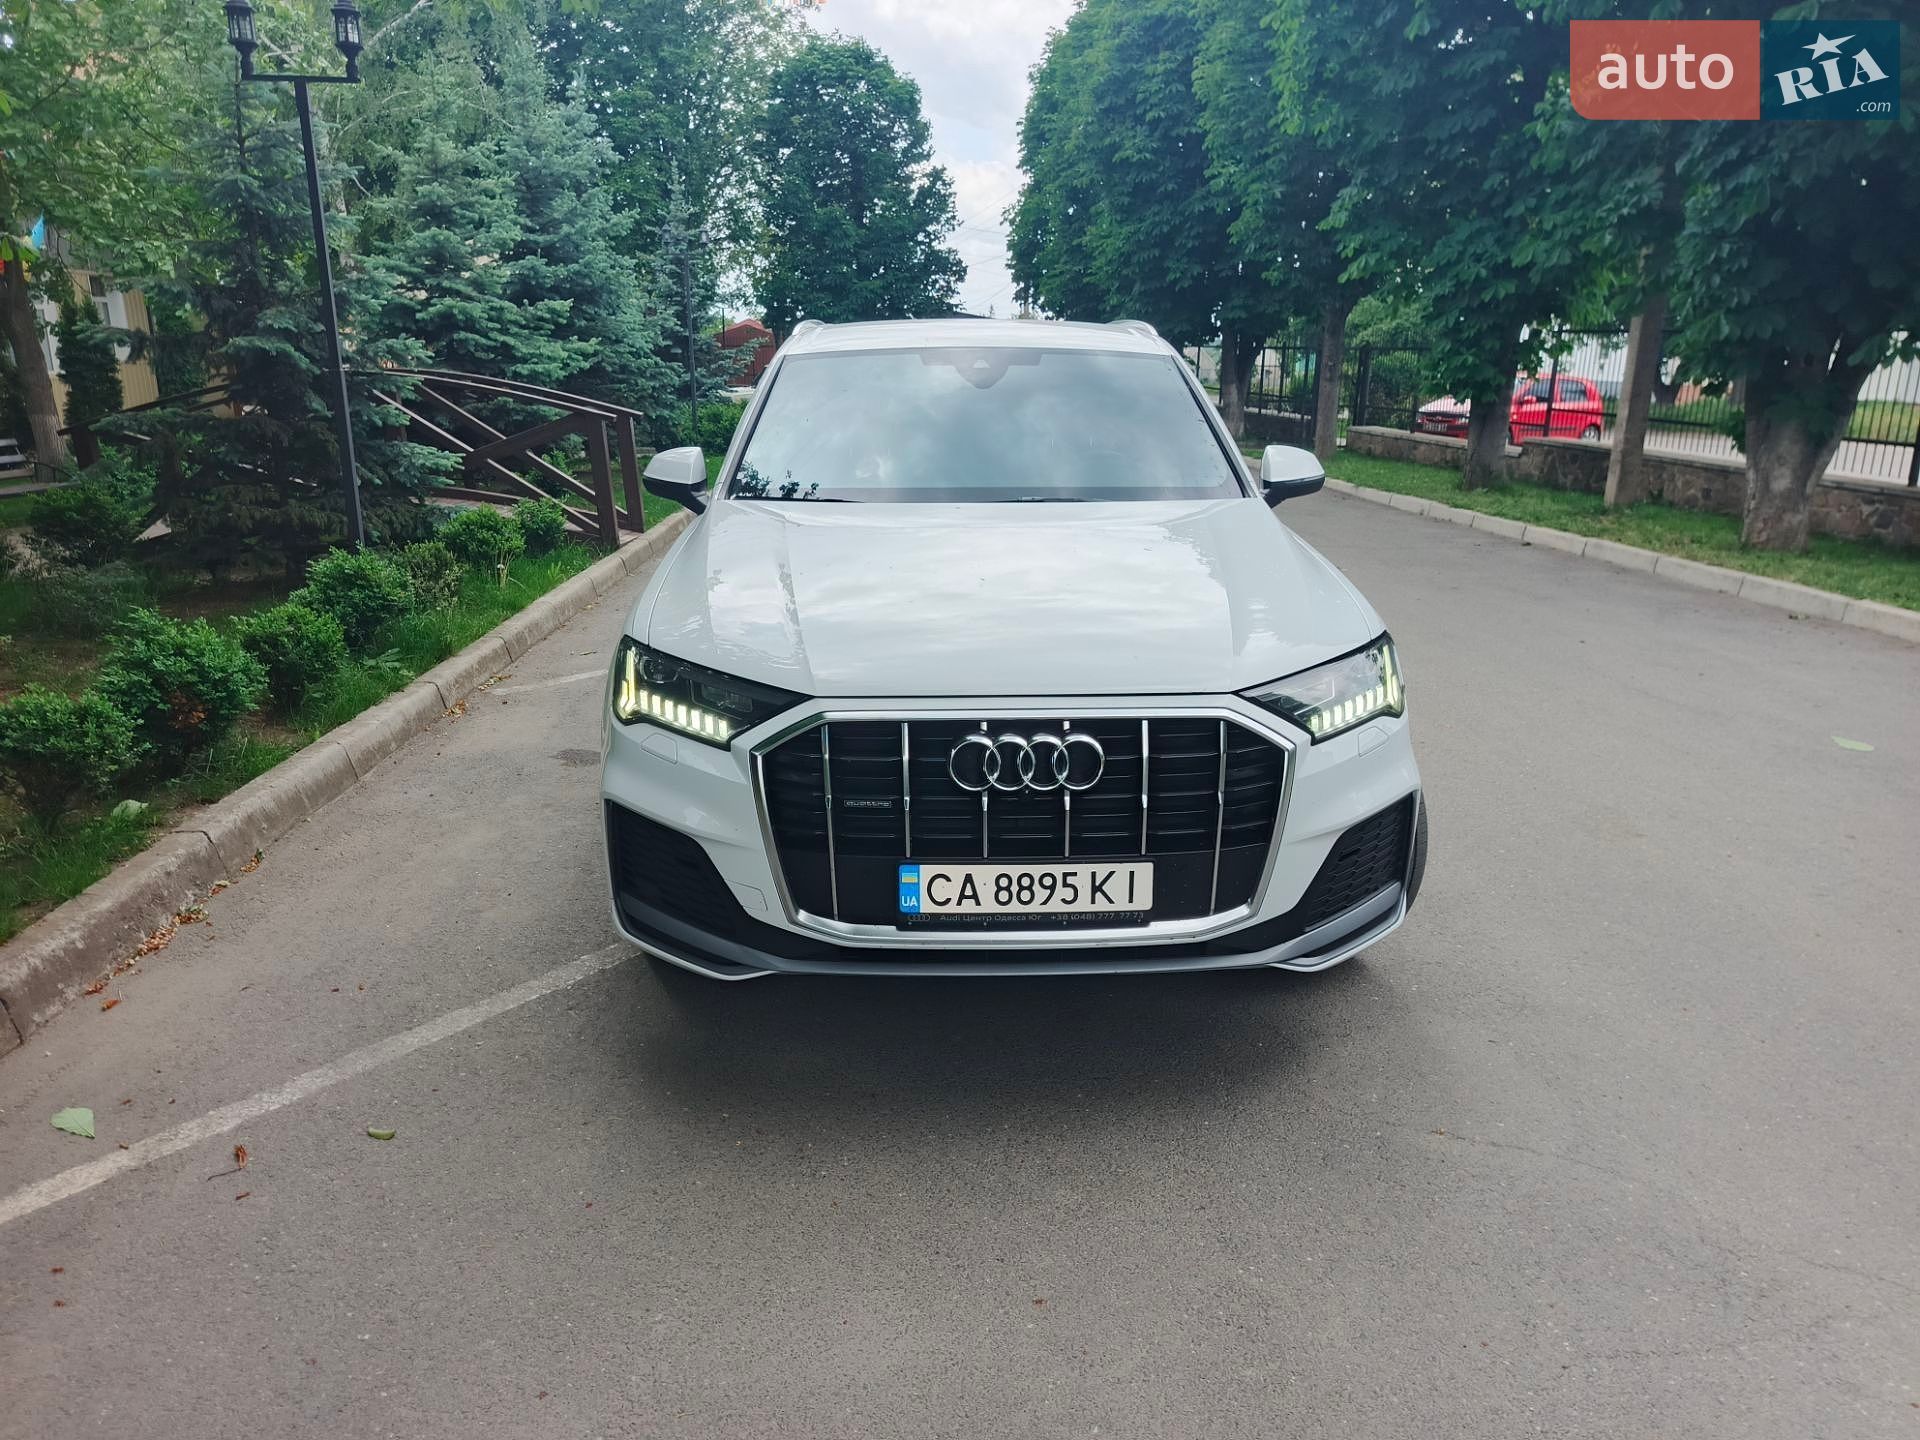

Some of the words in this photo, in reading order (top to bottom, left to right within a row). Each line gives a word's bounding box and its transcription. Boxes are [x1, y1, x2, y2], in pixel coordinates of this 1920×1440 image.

[926, 873, 982, 907] CA
[993, 871, 1079, 907] 8895
[1090, 870, 1135, 905] KI
[901, 895, 918, 907] UA
[963, 914, 992, 923] Центр
[994, 914, 1026, 922] Одесса
